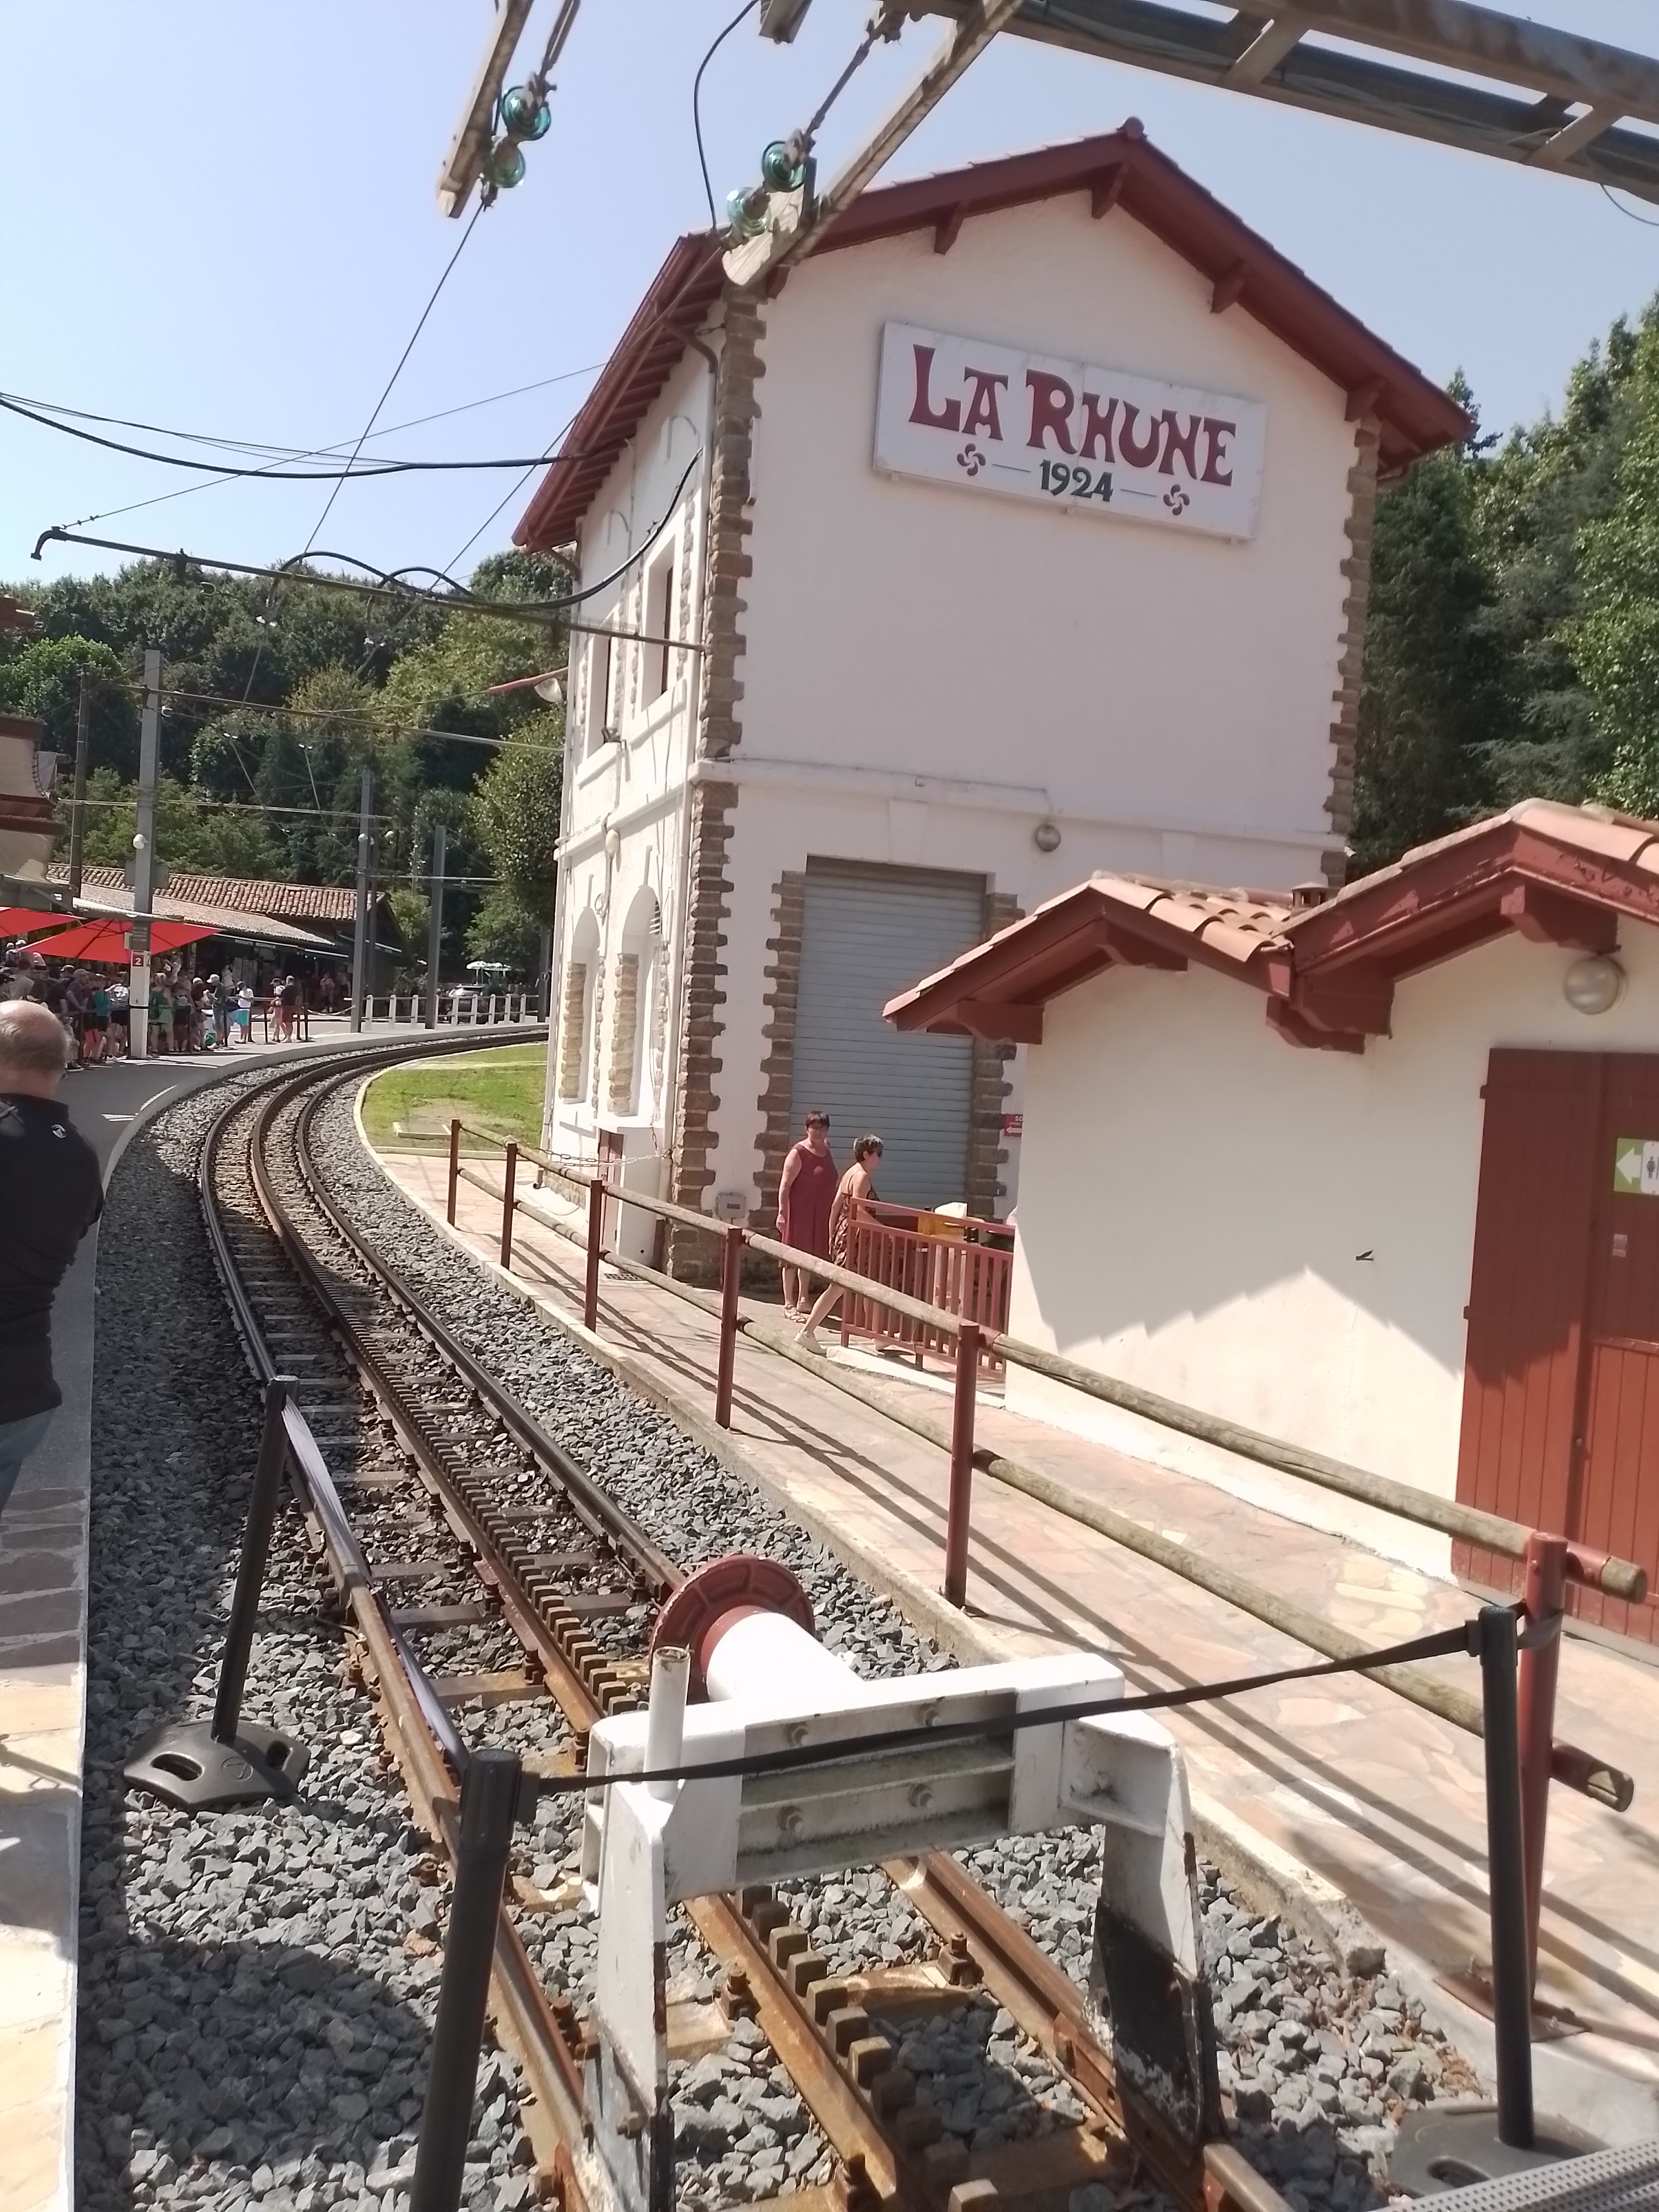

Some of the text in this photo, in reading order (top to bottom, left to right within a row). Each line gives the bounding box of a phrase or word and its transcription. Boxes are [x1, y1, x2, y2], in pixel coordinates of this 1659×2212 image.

[909, 344, 1237, 486] LA RHUNE
[1039, 459, 1113, 502] 1924
[135, 957, 142, 966] 2
